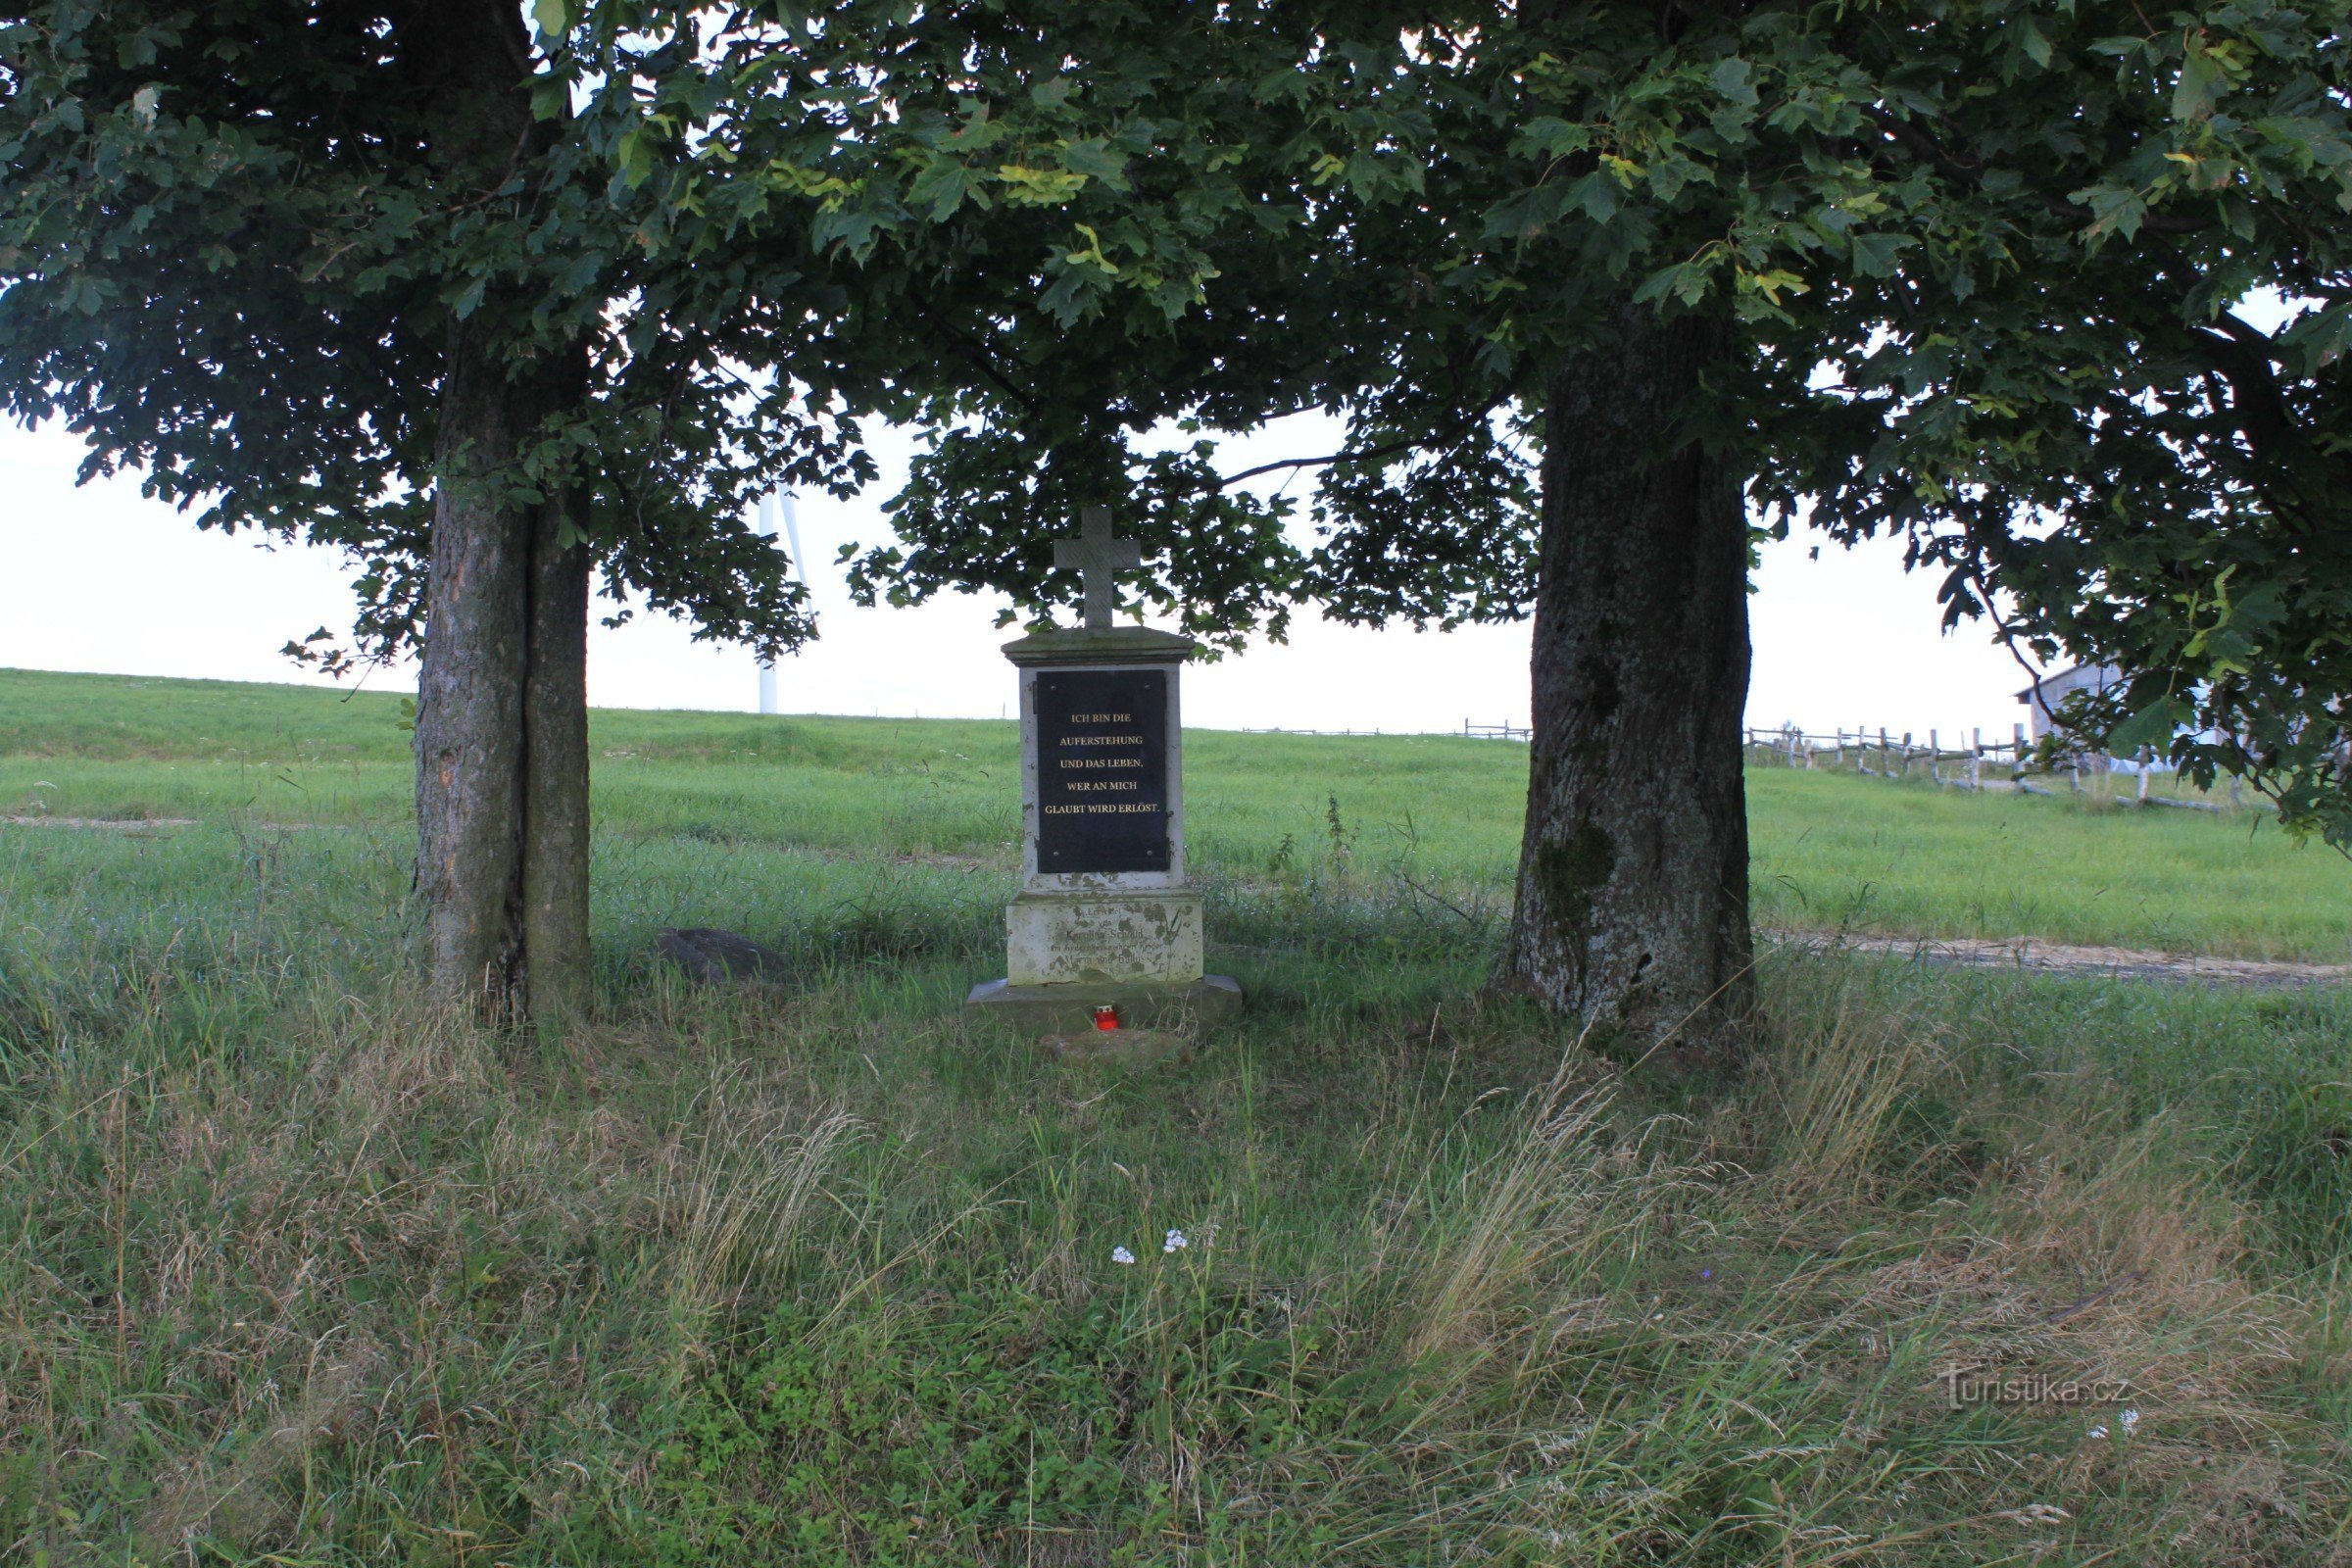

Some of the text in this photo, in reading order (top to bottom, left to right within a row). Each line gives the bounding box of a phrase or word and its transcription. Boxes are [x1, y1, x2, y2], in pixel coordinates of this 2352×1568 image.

[1071, 713, 1132, 723] ICH BIN DIE
[1059, 736, 1143, 746] AUFERSTEHUNG
[1060, 759, 1144, 768] UND DAS LEBEN,
[1067, 781, 1137, 791] WER AN MICH
[1045, 802, 1160, 814] GLAUBT WIRD ERLÖST.
